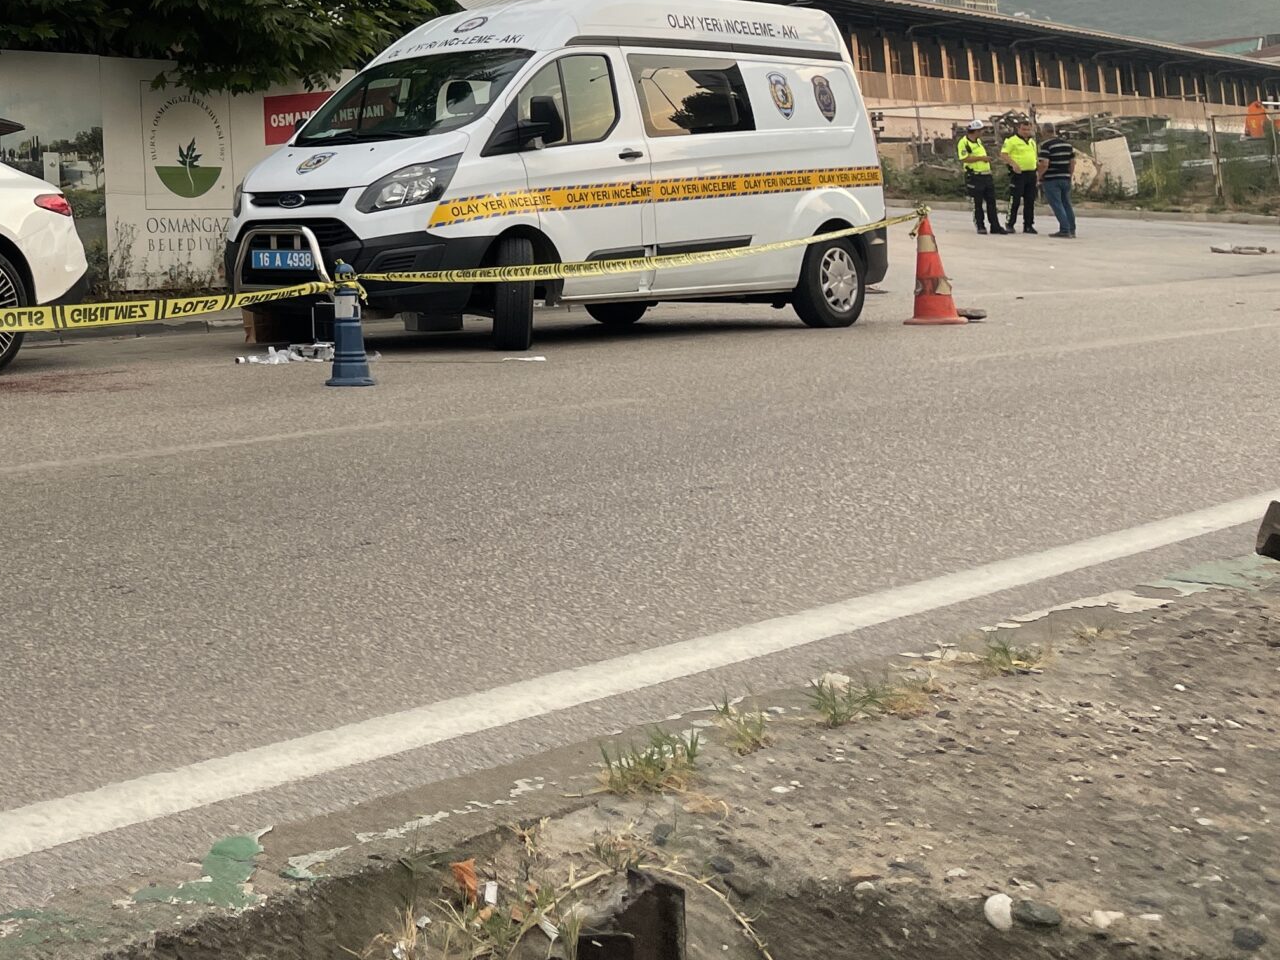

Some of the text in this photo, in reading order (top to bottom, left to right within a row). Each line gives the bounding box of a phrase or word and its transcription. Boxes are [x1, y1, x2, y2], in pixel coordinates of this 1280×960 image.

[667, 14, 696, 30] OLAY
[697, 16, 724, 32] YERİ
[724, 19, 776, 37] İNCELEME
[781, 25, 800, 40] AKİ
[743, 176, 811, 189] OLAY YERİ İNCELEME
[818, 171, 879, 183] OLAY YERİ İNCELEME
[660, 181, 737, 196] OLAY YERİ İNCELEME
[566, 192, 589, 203] OLAY
[590, 190, 611, 201] YERİ
[451, 195, 551, 217] OLAY YERİ İNCELEME
[146, 217, 230, 233] OSMANGAZ
[259, 253, 312, 267] 16 A 4938
